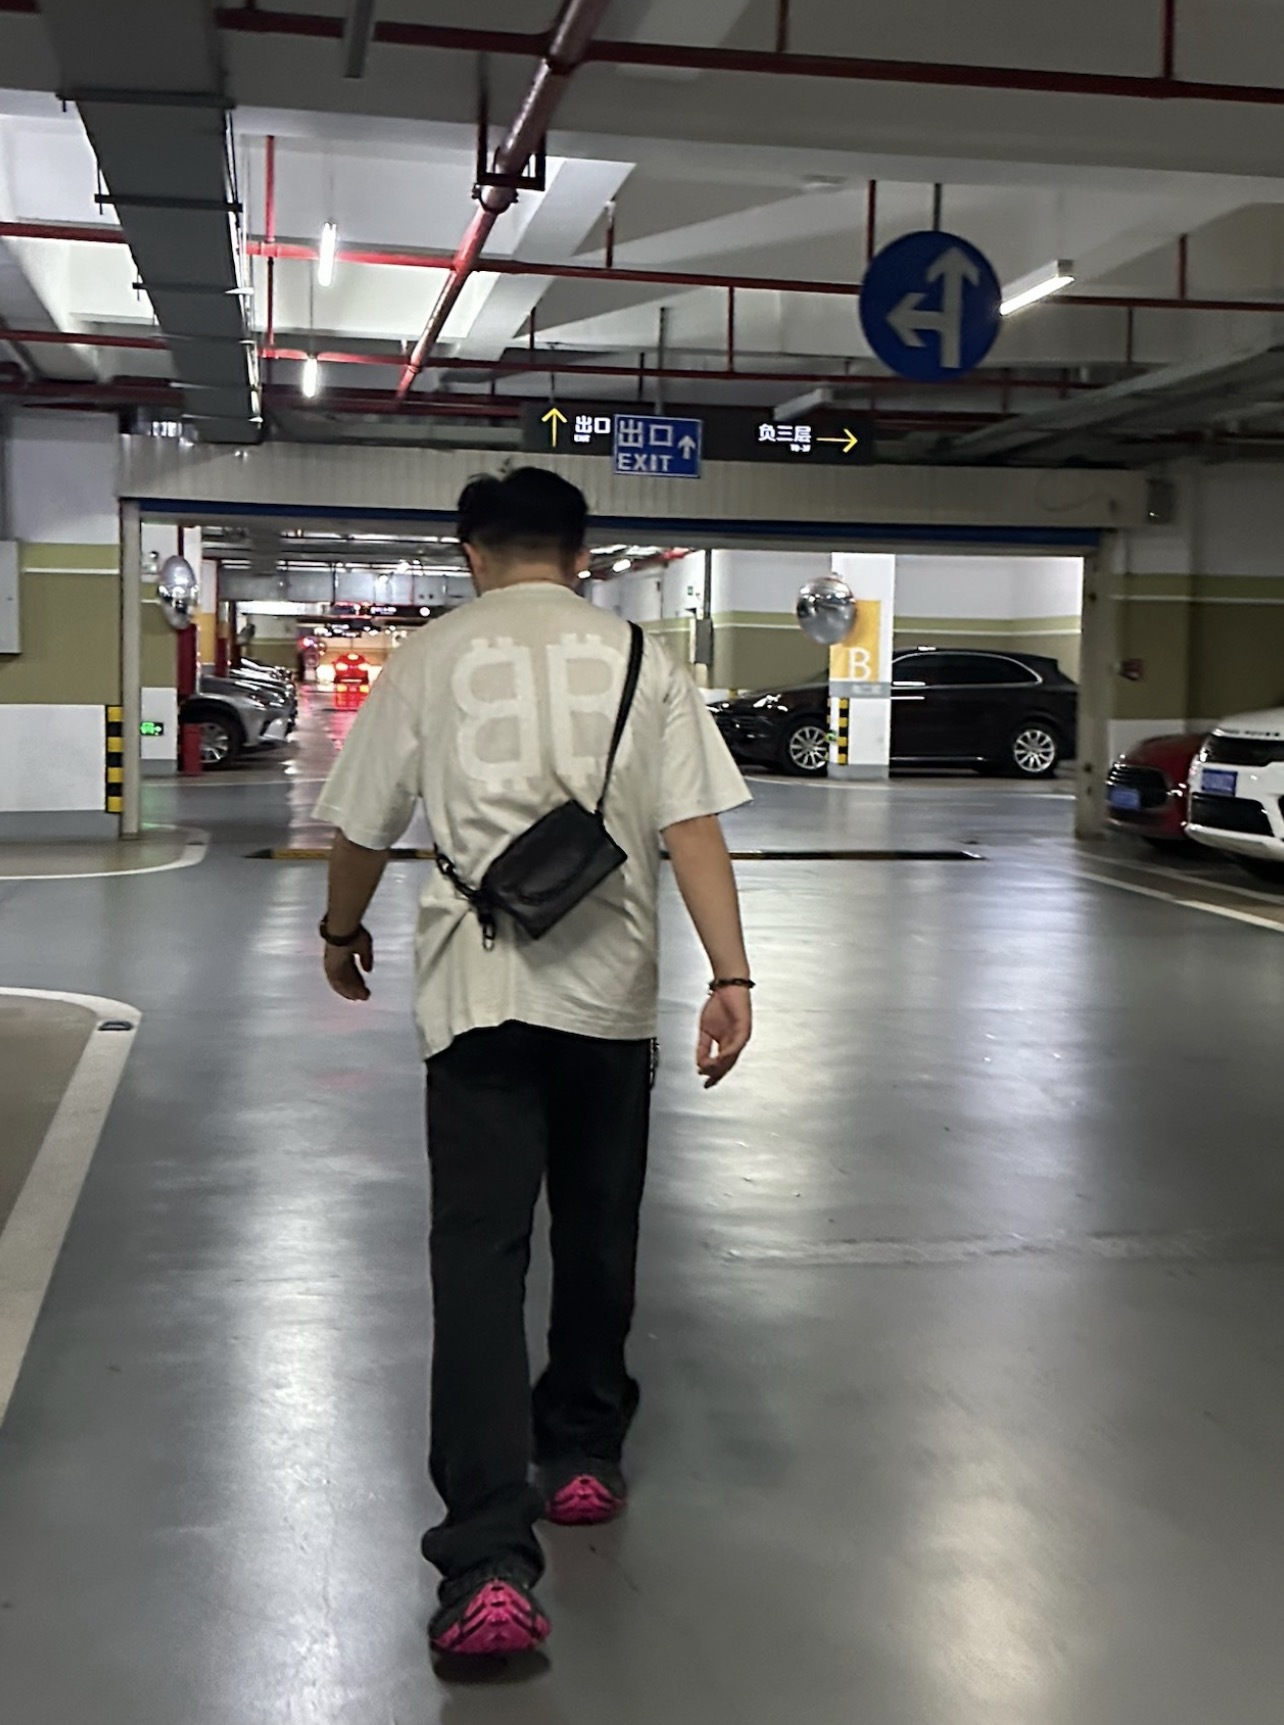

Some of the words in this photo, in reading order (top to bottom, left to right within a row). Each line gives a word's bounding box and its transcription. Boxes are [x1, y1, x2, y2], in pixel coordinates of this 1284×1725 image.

[575, 415, 611, 434] 出口
[618, 419, 673, 448] 出口
[758, 423, 812, 443] 负三层
[617, 452, 673, 472] EXIT
[848, 647, 872, 681] B
